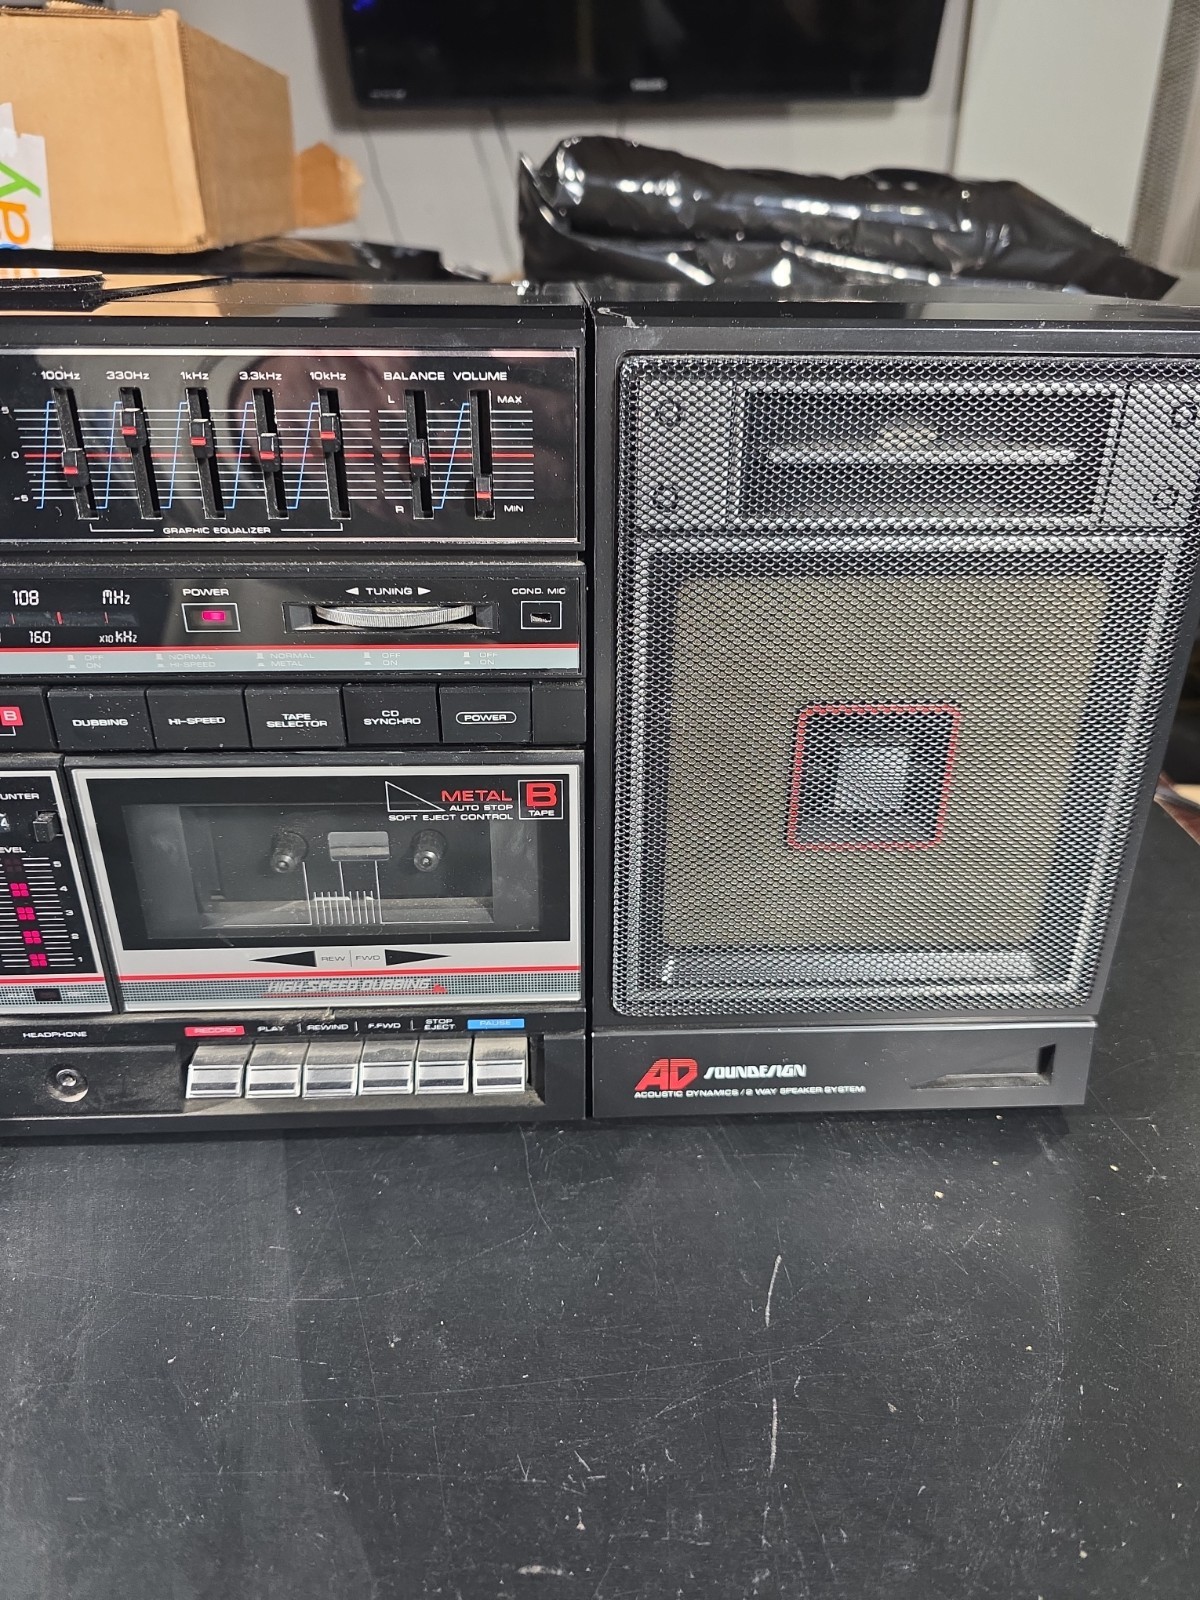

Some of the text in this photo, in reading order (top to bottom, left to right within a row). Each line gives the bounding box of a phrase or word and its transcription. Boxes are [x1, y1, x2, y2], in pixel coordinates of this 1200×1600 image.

[41, 371, 81, 381] 100Hz
[106, 371, 150, 380] 330Hz
[180, 371, 209, 380] 1kHz
[239, 371, 282, 381] 3.3kHz
[309, 371, 346, 381] 10kHz
[384, 372, 445, 381] BALANCE
[453, 371, 507, 381] VOLUME
[388, 395, 395, 404] L
[497, 395, 522, 404] MAX
[11, 451, 20, 459] 0
[395, 506, 404, 514] R
[504, 505, 524, 513] MIN
[163, 526, 271, 535] GRAPHIC EQUALIZER
[183, 588, 229, 596] POWER
[365, 587, 413, 596] TUNING
[547, 587, 567, 595] MIC
[12, 590, 40, 606] 108
[102, 590, 131, 605] MHz
[29, 630, 51, 644] 160
[270, 652, 315, 660] NORMAL
[170, 661, 216, 669] HI-SPEED
[3, 710, 18, 721] B
[281, 713, 311, 721] TAPE
[464, 714, 507, 722] POWER
[72, 718, 129, 727] DUBBING
[168, 716, 226, 726] HI-SPEED
[266, 719, 328, 729] SELECTOR
[363, 717, 421, 726] SYNCHRO
[441, 790, 513, 802] METAL
[525, 782, 557, 806] B
[388, 814, 417, 822] SOFT
[460, 813, 513, 821] CONTROL
[528, 809, 555, 817] TAPE
[321, 954, 381, 963] REW FWD
[360, 978, 432, 991] DUBBING
[307, 1022, 349, 1031] REWIND
[368, 1022, 401, 1030] F.FWD
[23, 1030, 87, 1038] HEADPHONE
[634, 1058, 698, 1091] AD
[703, 1063, 807, 1080] SOUNDESIGN
[634, 1090, 683, 1099] ACOUSTIC
[686, 1089, 739, 1098] DYNAMICS
[756, 1087, 778, 1096] WAY
[780, 1086, 823, 1096] SPEAKER
[824, 1085, 867, 1095] SYSTEM
